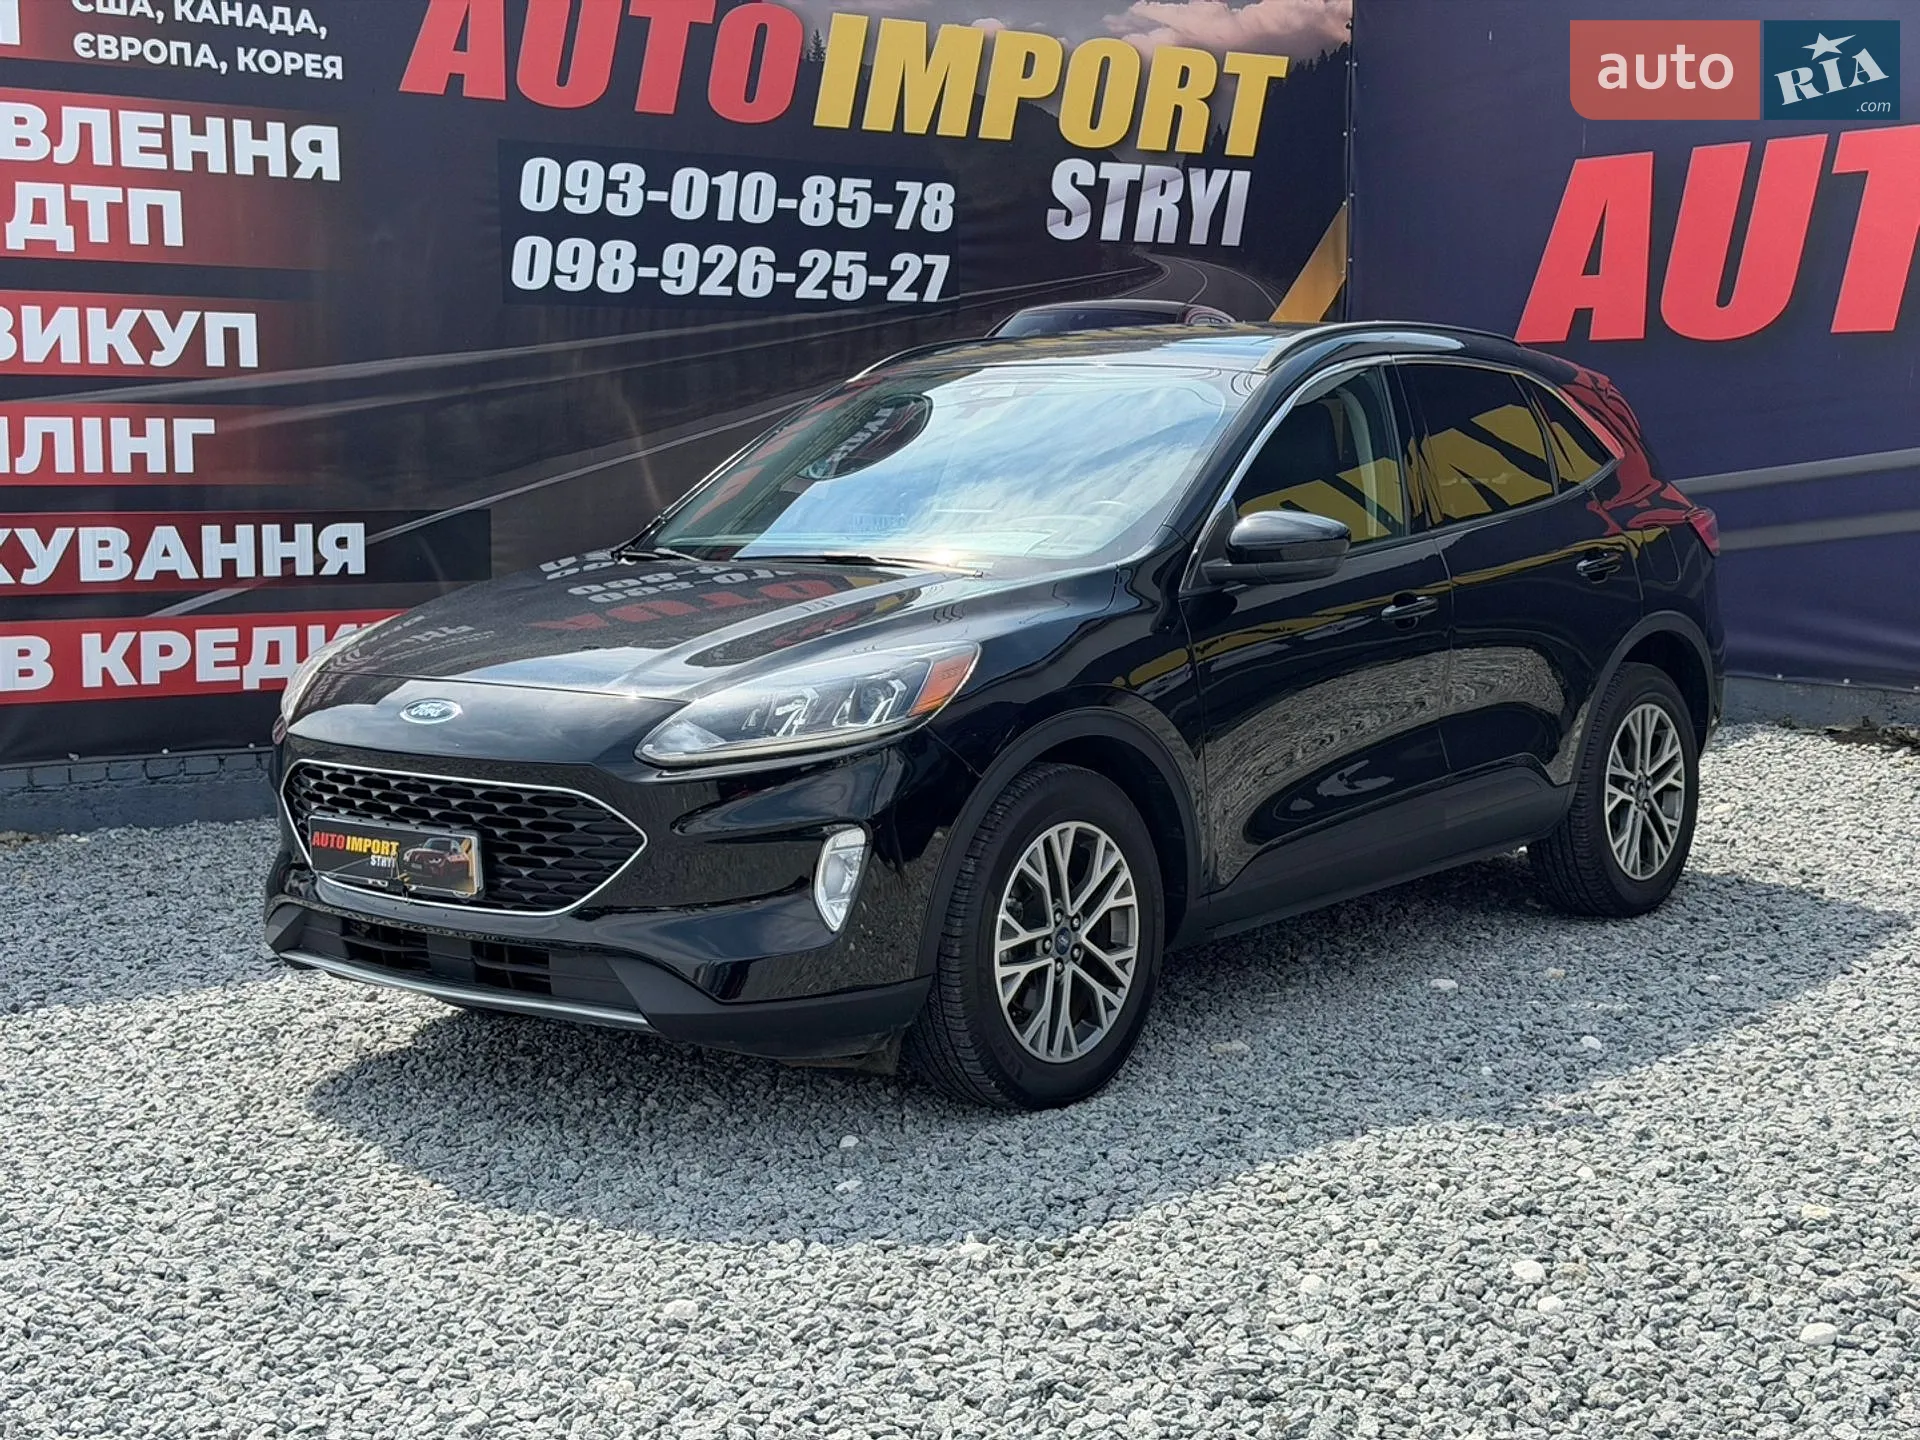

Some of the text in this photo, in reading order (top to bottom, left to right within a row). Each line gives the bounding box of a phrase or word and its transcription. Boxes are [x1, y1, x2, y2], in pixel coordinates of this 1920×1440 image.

[174, 0, 328, 40] КАНАДА,
[73, 32, 344, 81] ЄВРОПА, КОРЕЯ
[0, 102, 341, 182] ВЛЕННЯ
[5, 181, 184, 253] ДТП
[519, 157, 956, 233] 093-010-85-78
[1046, 158, 1252, 247] STRYI
[1514, 124, 1920, 344] AUT
[511, 235, 951, 303] 098-926-25-27
[0, 417, 216, 475] ЛІНГ
[0, 523, 366, 585] УВАННЯ
[0, 623, 373, 692] В КРЕД
